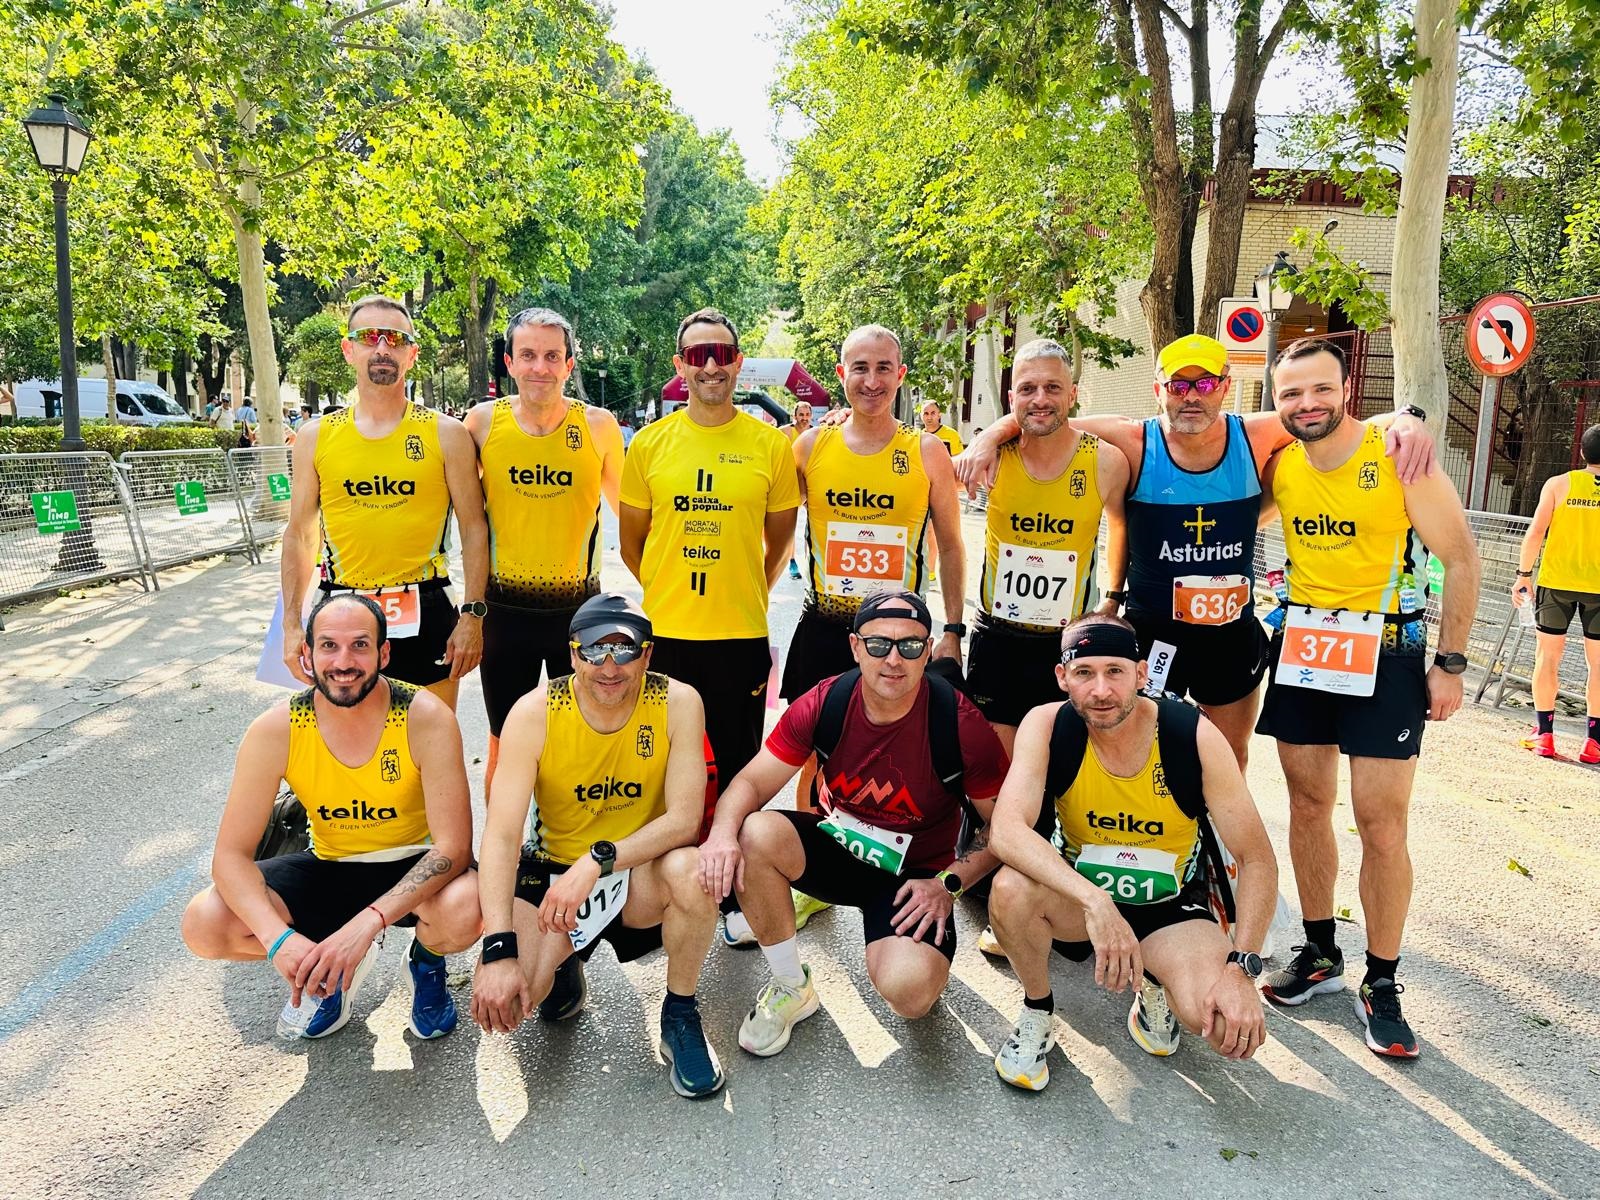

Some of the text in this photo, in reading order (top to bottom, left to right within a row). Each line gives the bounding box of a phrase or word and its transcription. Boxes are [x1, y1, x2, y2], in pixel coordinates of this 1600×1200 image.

[343, 475, 415, 496] teika
[509, 464, 572, 486] teika
[692, 496, 719, 504] caixa
[692, 504, 734, 512] popular
[826, 487, 894, 510] teika
[686, 526, 719, 534] PALOMINO
[1010, 512, 1074, 534] teika
[1293, 514, 1356, 536] teika
[683, 545, 720, 559] teika
[840, 547, 889, 575] 533
[1159, 540, 1242, 562] Asturias
[1003, 570, 1067, 601] 1007
[1190, 593, 1238, 619] 636
[1300, 635, 1354, 665] 371
[574, 776, 642, 802] teika
[317, 800, 397, 820] teika
[1086, 810, 1163, 836] teika
[1095, 871, 1154, 900] 261
